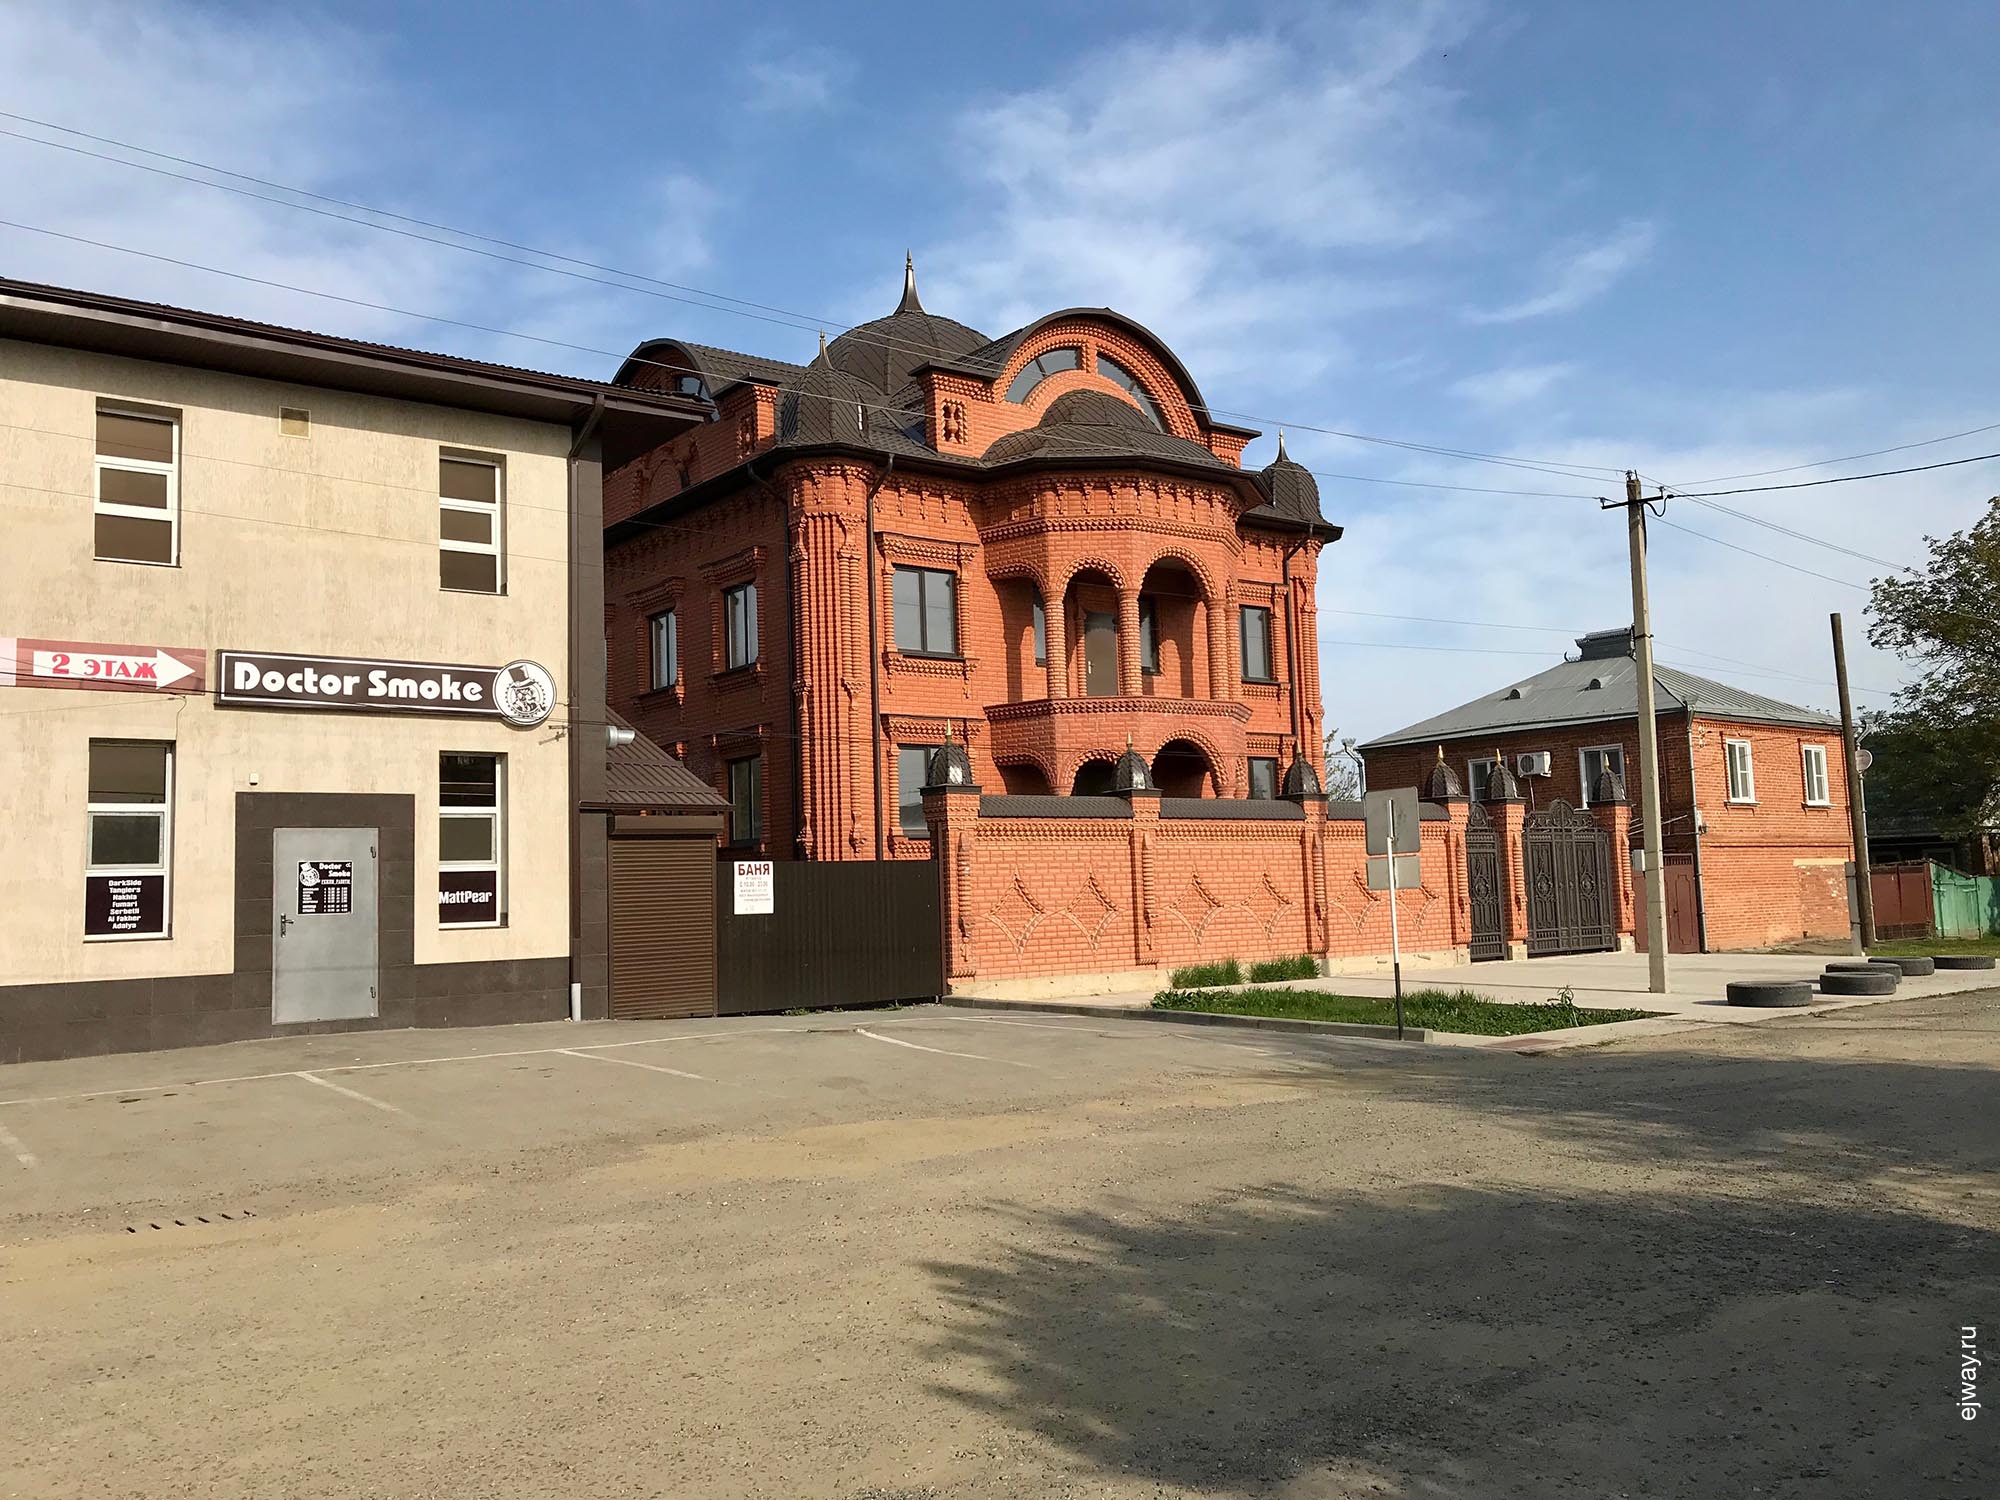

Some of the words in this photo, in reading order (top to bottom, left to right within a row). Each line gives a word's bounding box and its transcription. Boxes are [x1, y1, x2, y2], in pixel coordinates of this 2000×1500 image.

[52, 653, 71, 675] 2
[84, 659, 158, 679] ЭТАЖ
[234, 661, 360, 696] Doctor
[367, 670, 483, 702] Smoke
[738, 863, 770, 876] БАНЯ
[439, 891, 492, 904] MattPear
